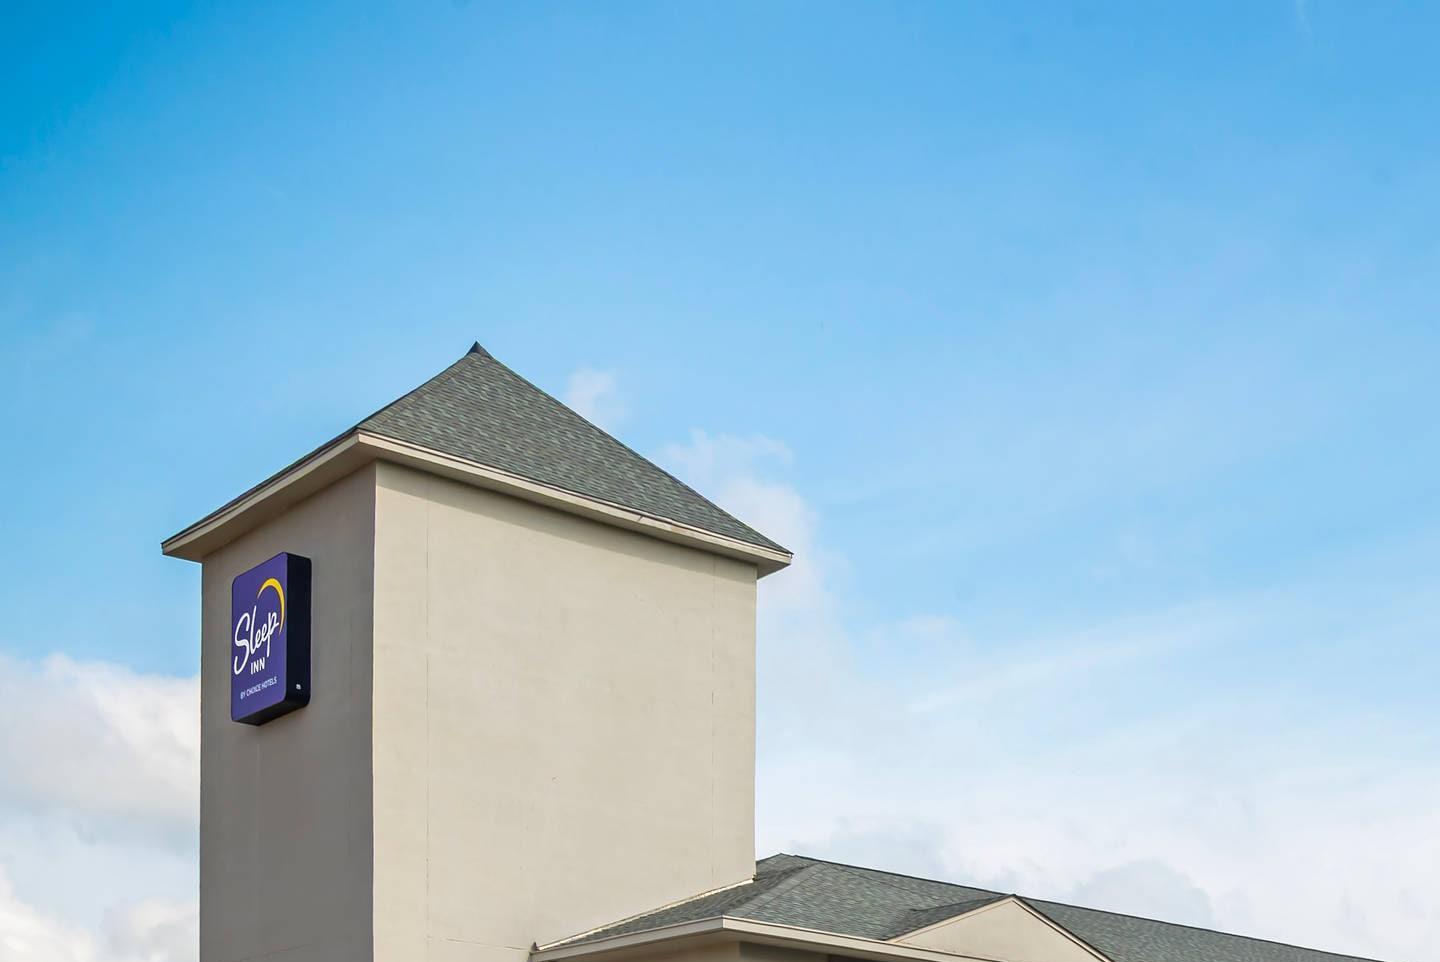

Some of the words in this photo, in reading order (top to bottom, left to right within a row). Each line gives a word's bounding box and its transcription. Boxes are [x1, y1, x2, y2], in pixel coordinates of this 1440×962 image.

[234, 606, 280, 675] Sleep
[250, 656, 266, 675] INN
[240, 690, 246, 700] BY
[246, 683, 261, 697] CHOICE
[261, 676, 277, 689] HOTELS
